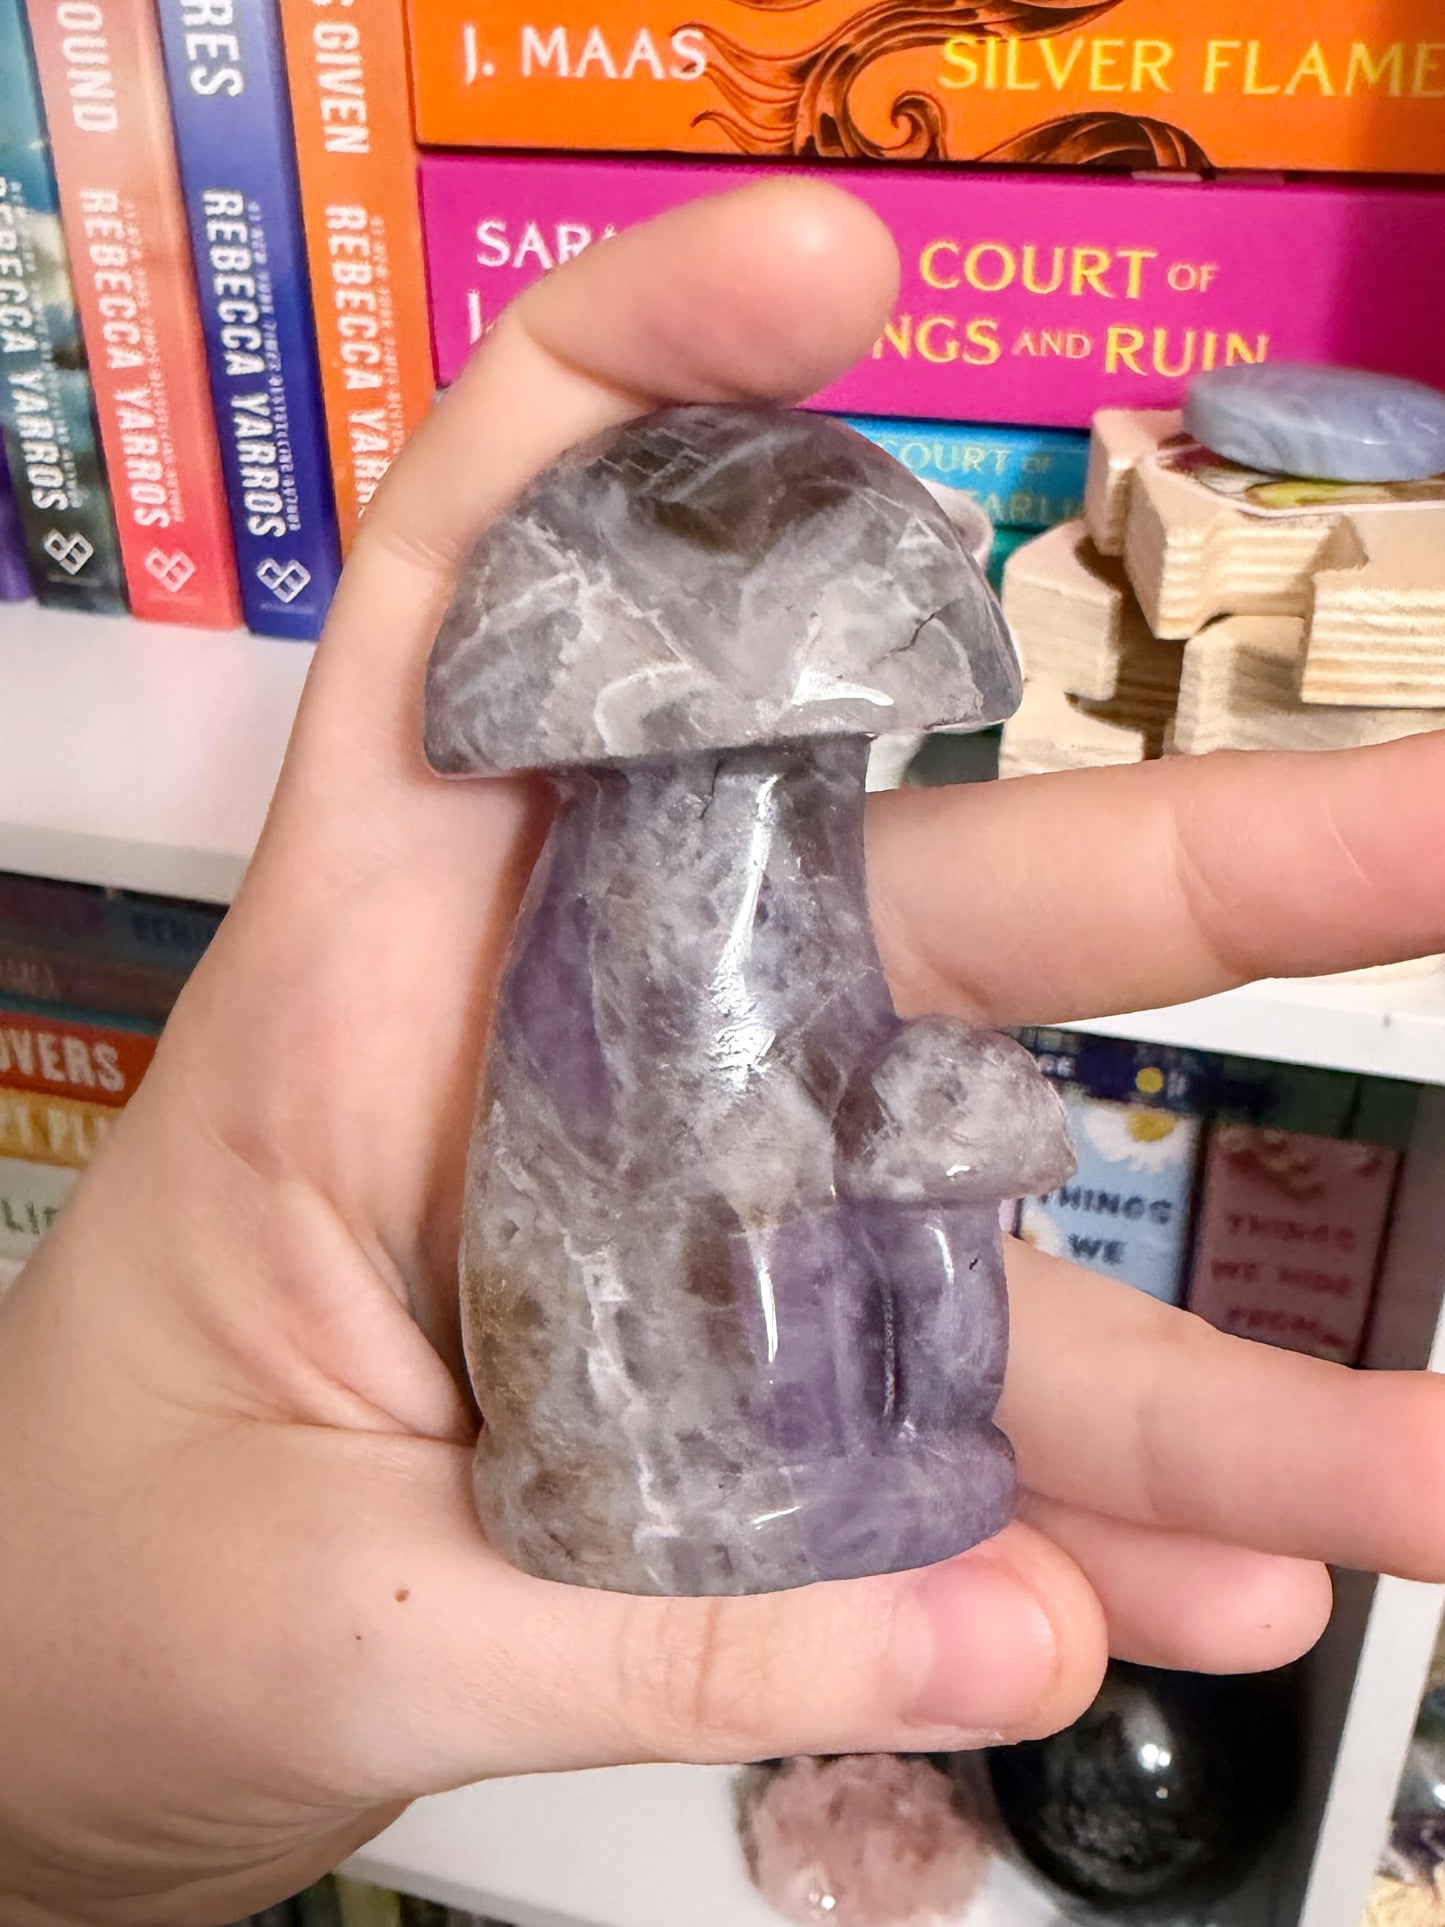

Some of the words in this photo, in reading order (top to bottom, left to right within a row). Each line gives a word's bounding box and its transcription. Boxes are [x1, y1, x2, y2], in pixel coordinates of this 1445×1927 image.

[56, 3, 118, 133] OUND
[313, 20, 370, 154] GIVEN
[463, 25, 495, 87] J.
[520, 25, 708, 80] MAAS
[937, 34, 1173, 93] SILVER
[1203, 40, 1445, 98] FLAME
[0, 176, 40, 353] BECCA
[202, 190, 267, 376] REBECCA
[325, 204, 384, 391] REBECCA
[475, 220, 618, 270] SAR
[919, 241, 1158, 300] COURT
[1166, 263, 1220, 293] OF
[80, 187, 145, 369] REBECCA
[113, 385, 171, 528] YARROS
[1011, 328, 1093, 361] AND
[1104, 326, 1270, 378] RUIN
[8, 369, 70, 511] YARROS
[230, 392, 287, 538] YARROS
[347, 409, 393, 520] YARR
[1068, 1232, 1127, 1266] WE
